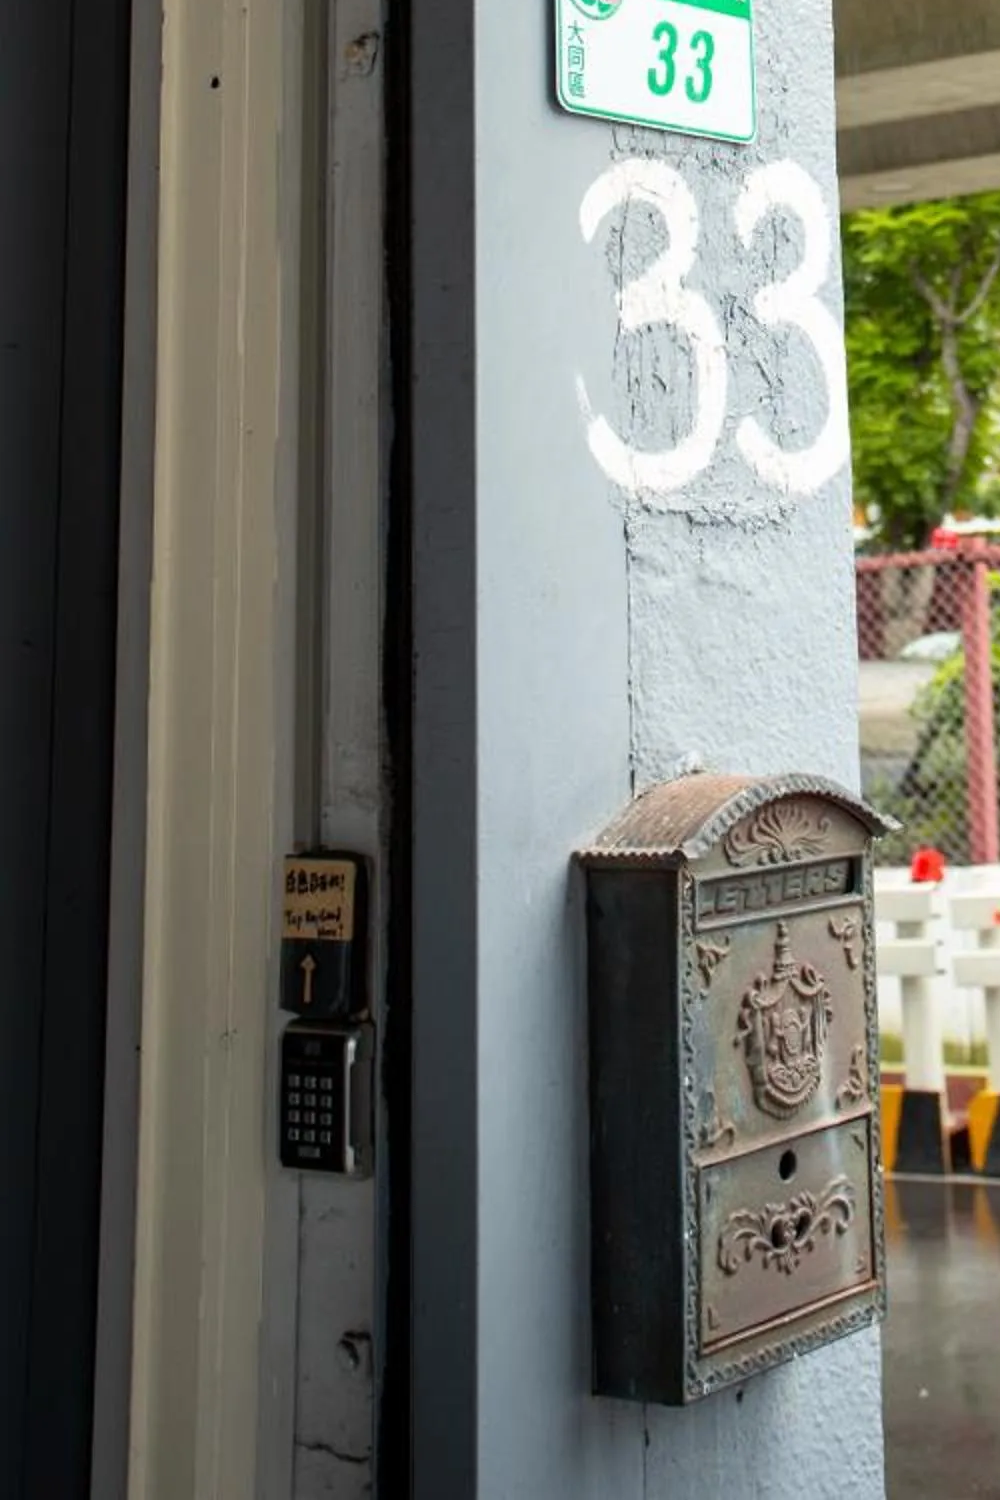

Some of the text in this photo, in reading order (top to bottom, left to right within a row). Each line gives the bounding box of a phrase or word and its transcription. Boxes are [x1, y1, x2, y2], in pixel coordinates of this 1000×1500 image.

[567, 19, 586, 99] 大同區
[647, 20, 715, 105] 33
[575, 156, 850, 496] 33
[699, 860, 848, 918] LETTERS
